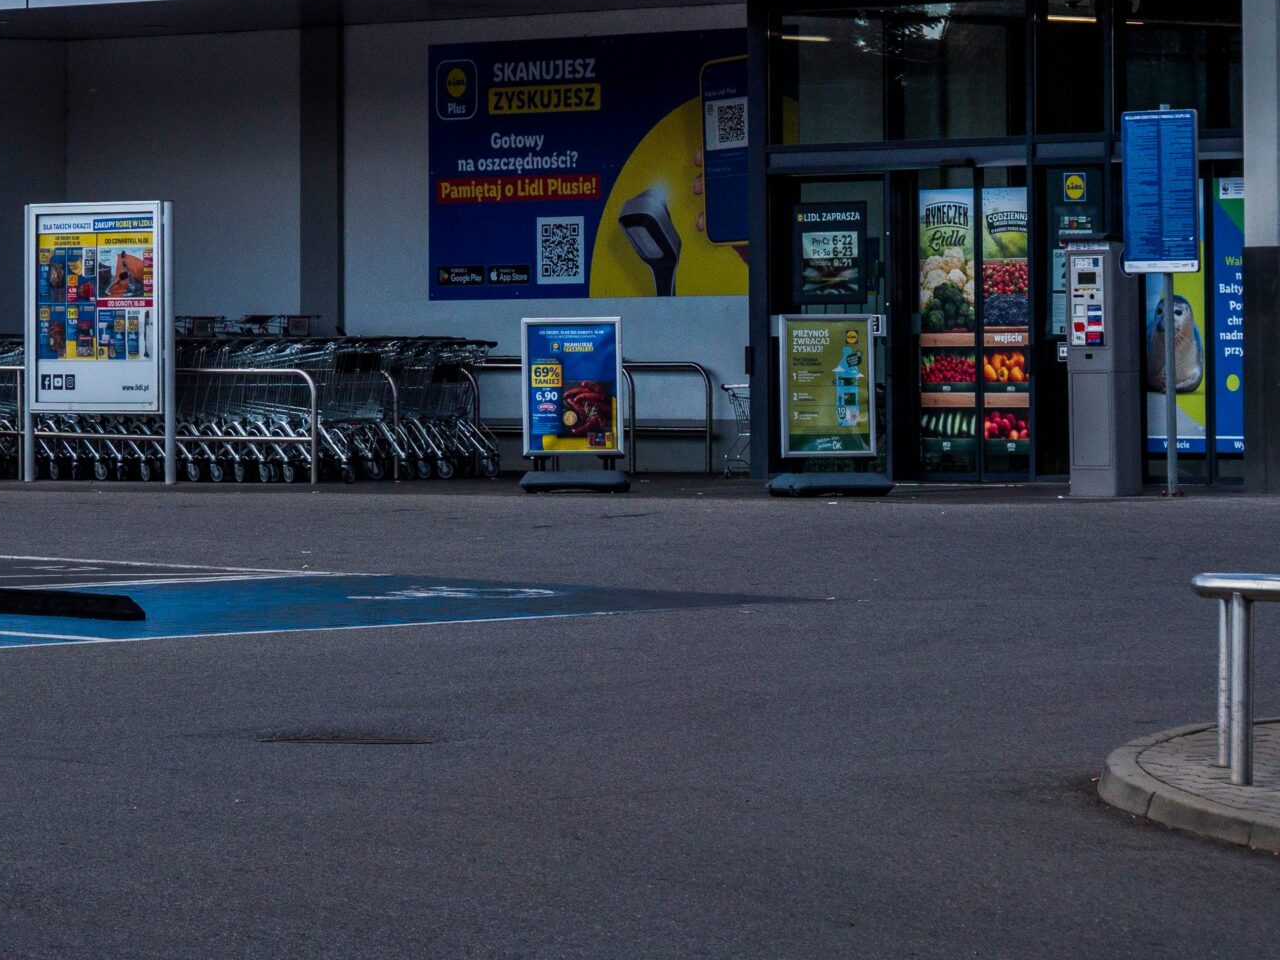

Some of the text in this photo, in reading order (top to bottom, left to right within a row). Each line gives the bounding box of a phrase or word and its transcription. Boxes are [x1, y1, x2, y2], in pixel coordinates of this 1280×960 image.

[493, 58, 596, 82] SKANUJESZ
[493, 87, 596, 111] ZYSKUJESZ
[447, 102, 466, 115] Plus
[490, 132, 544, 151] Gotowy
[458, 150, 579, 174] na oszczędności?
[440, 176, 597, 202] Pamiętaj o Lidl Plusie!
[804, 211, 861, 222] LIDL ZAPRASZA
[925, 204, 969, 229] RYNECZEK
[95, 221, 116, 229] ZAKUPY
[832, 235, 853, 246] 6-22
[928, 229, 966, 252] Lidla
[832, 246, 853, 257] 6-23
[450, 274, 470, 284] Google
[499, 273, 511, 282] App
[793, 328, 829, 338] PRZYNOŚ
[994, 332, 1023, 344] wejście
[793, 337, 830, 345] ZWRACAJ
[793, 345, 824, 353] ZYSKUJ!
[534, 366, 560, 378] 69%
[536, 391, 558, 402] 6,90
[793, 393, 798, 401] 2
[1164, 439, 1190, 449] Wście
